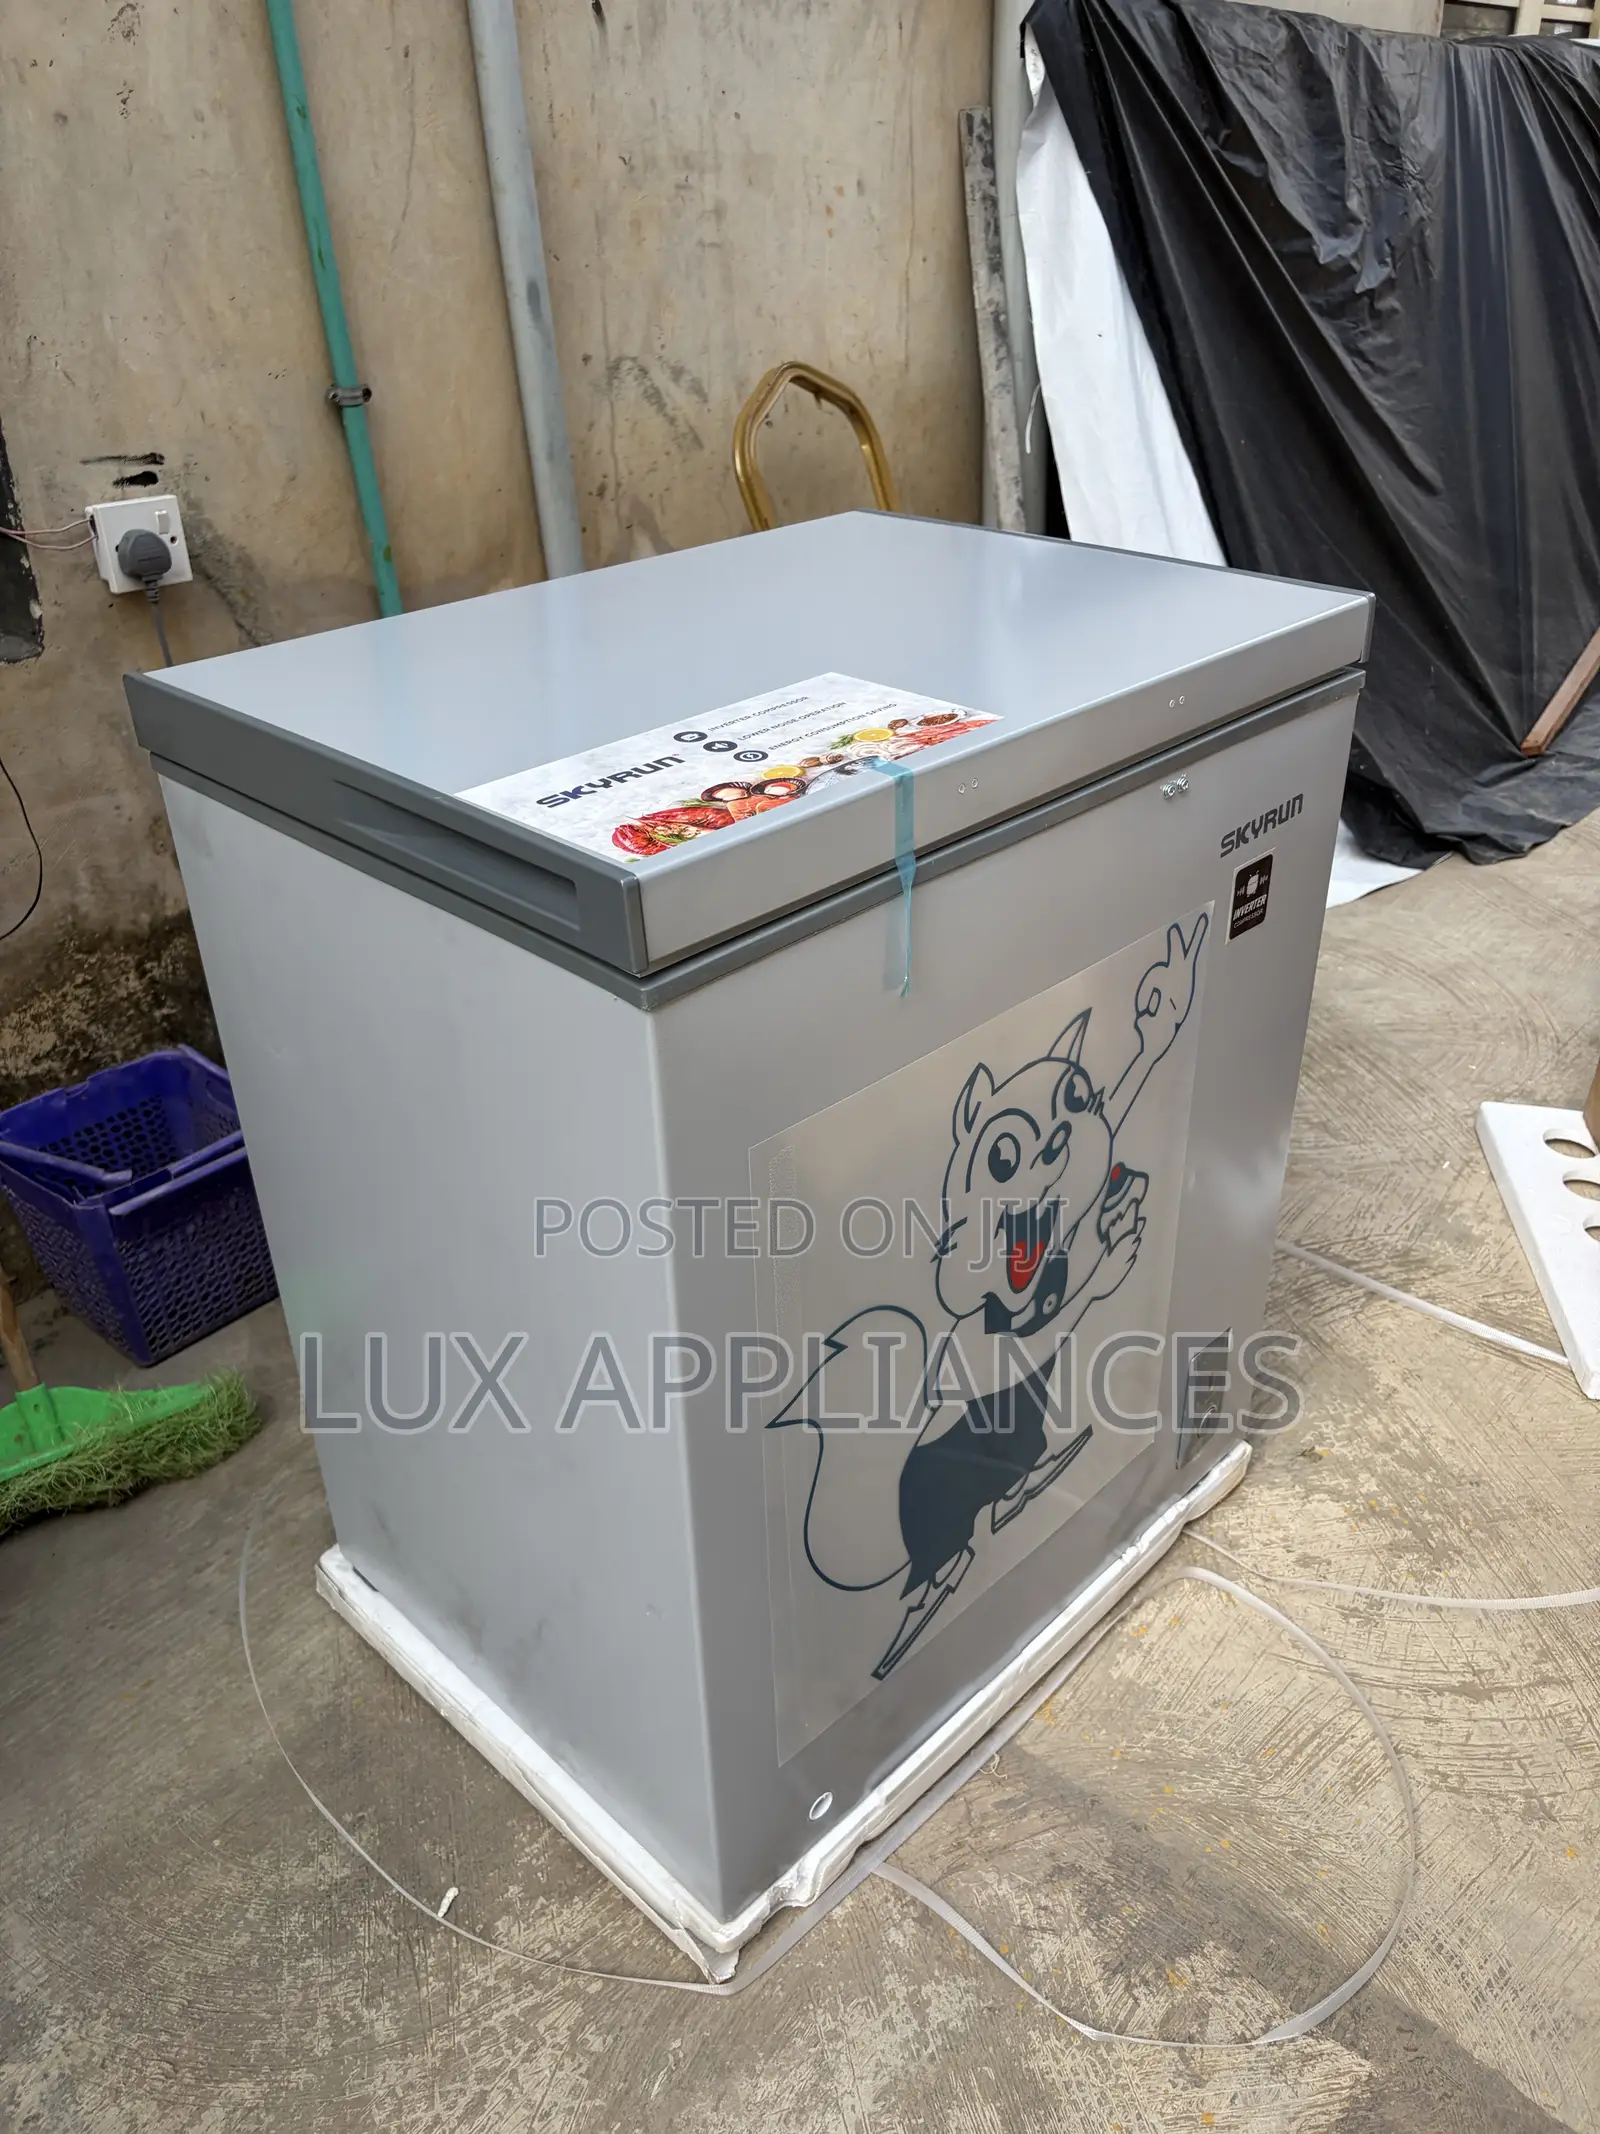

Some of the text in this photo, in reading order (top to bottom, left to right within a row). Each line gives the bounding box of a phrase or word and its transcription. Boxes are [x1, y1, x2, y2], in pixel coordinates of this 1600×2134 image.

[708, 696, 809, 732] INVERTER COMPRESSOR
[737, 701, 847, 741] LOWER NOISE OPERATION
[768, 703, 897, 751] ENERGY CONSUMPTION SAVING
[536, 756, 685, 808] SKYRUN
[1220, 793, 1303, 858] SKYRUN
[1232, 893, 1267, 921] INVERTER
[1233, 908, 1264, 929] COMPRESSOR
